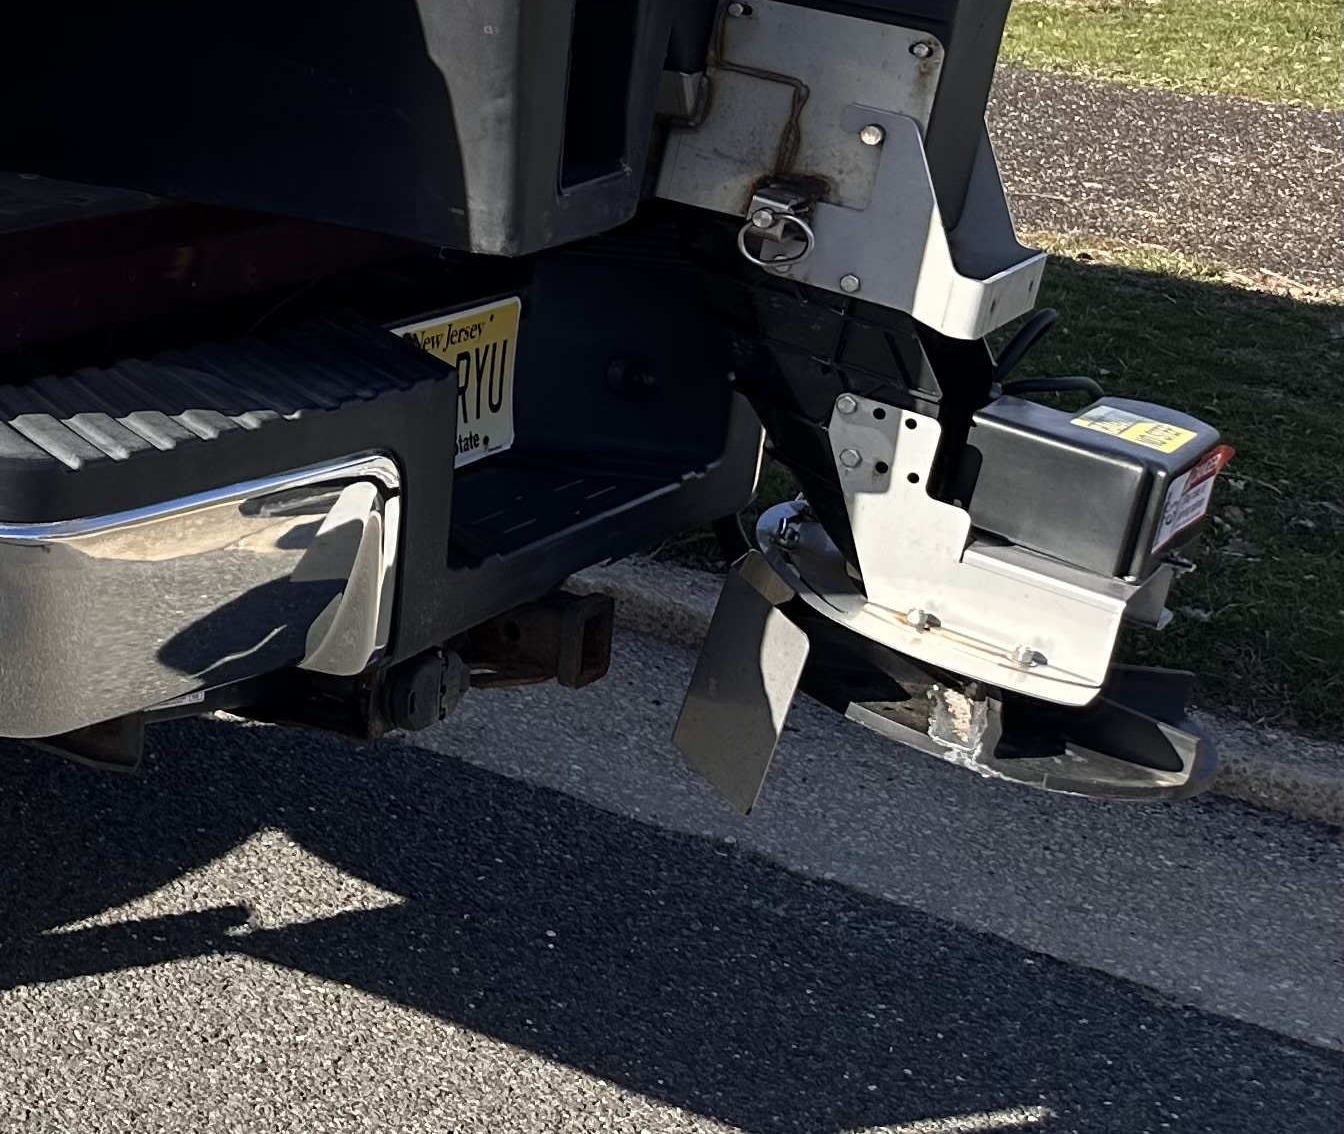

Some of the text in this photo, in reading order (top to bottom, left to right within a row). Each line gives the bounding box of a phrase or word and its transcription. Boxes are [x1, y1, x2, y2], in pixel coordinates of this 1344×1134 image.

[442, 322, 485, 353] Jersey
[455, 339, 508, 424] RYU
[455, 430, 480, 454] tate
